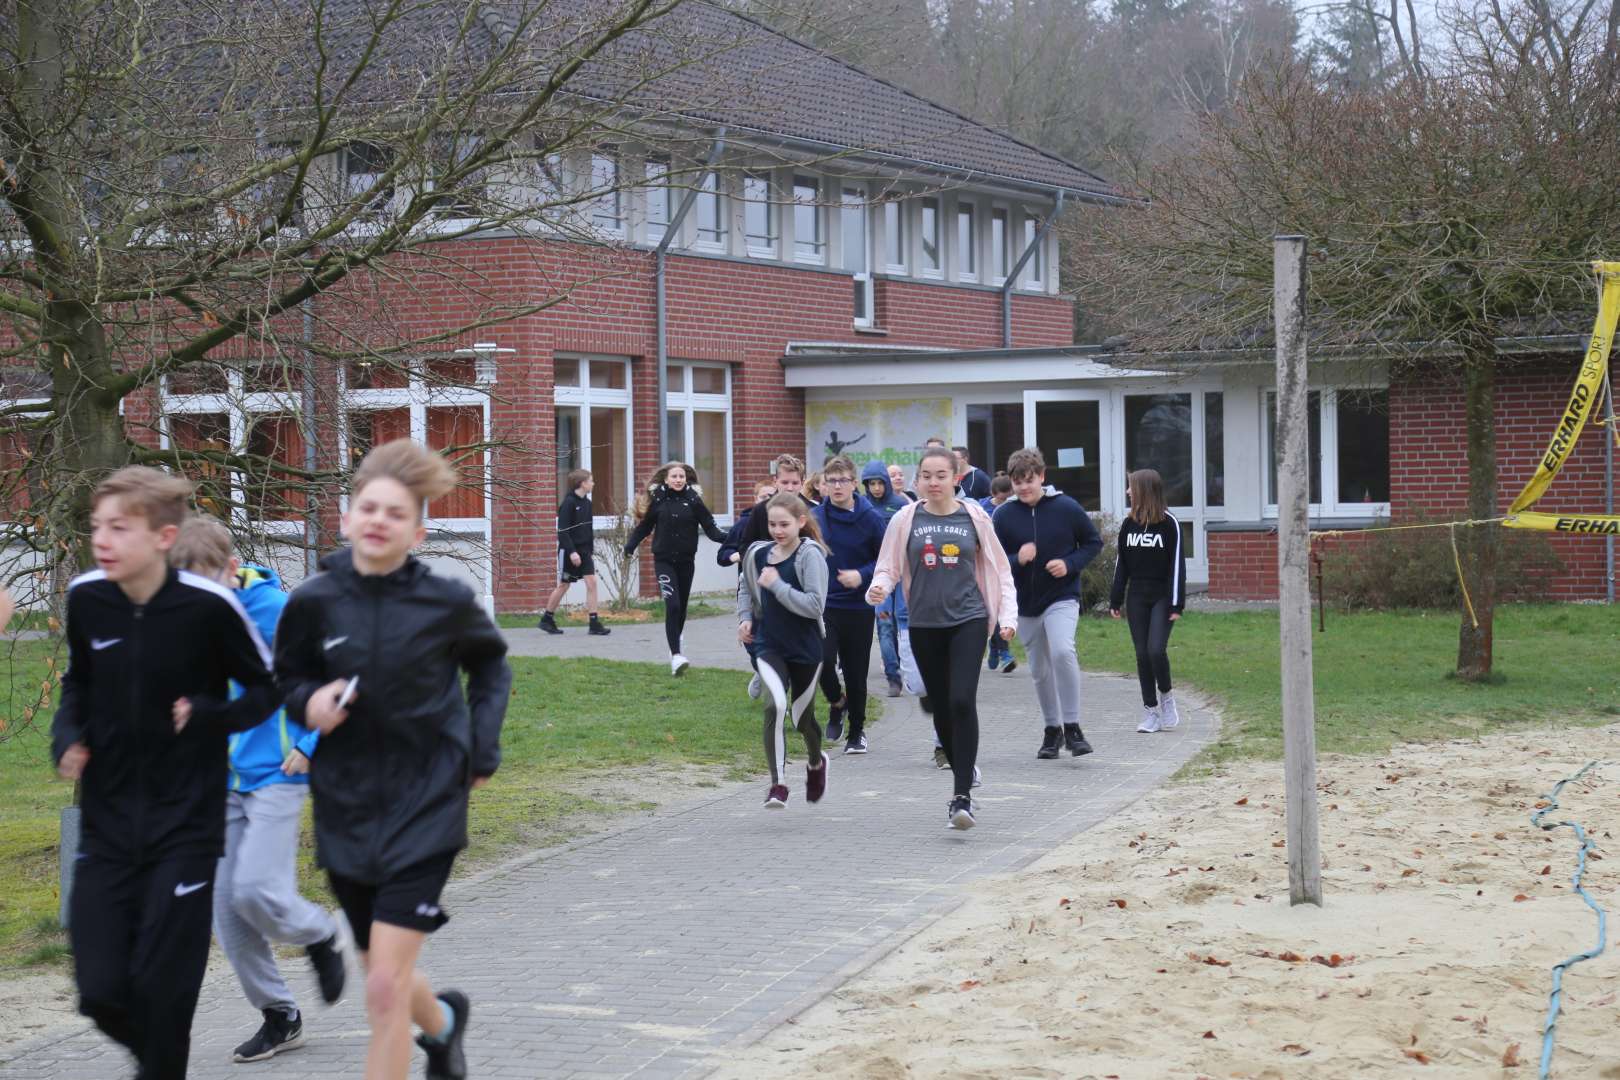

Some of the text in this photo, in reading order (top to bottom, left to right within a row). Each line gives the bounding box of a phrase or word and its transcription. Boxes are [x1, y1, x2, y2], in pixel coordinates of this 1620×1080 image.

[1543, 335, 1605, 472] ERHARD SPORT
[913, 525, 968, 537] COUPLE GOALS
[1126, 533, 1164, 548] NASA
